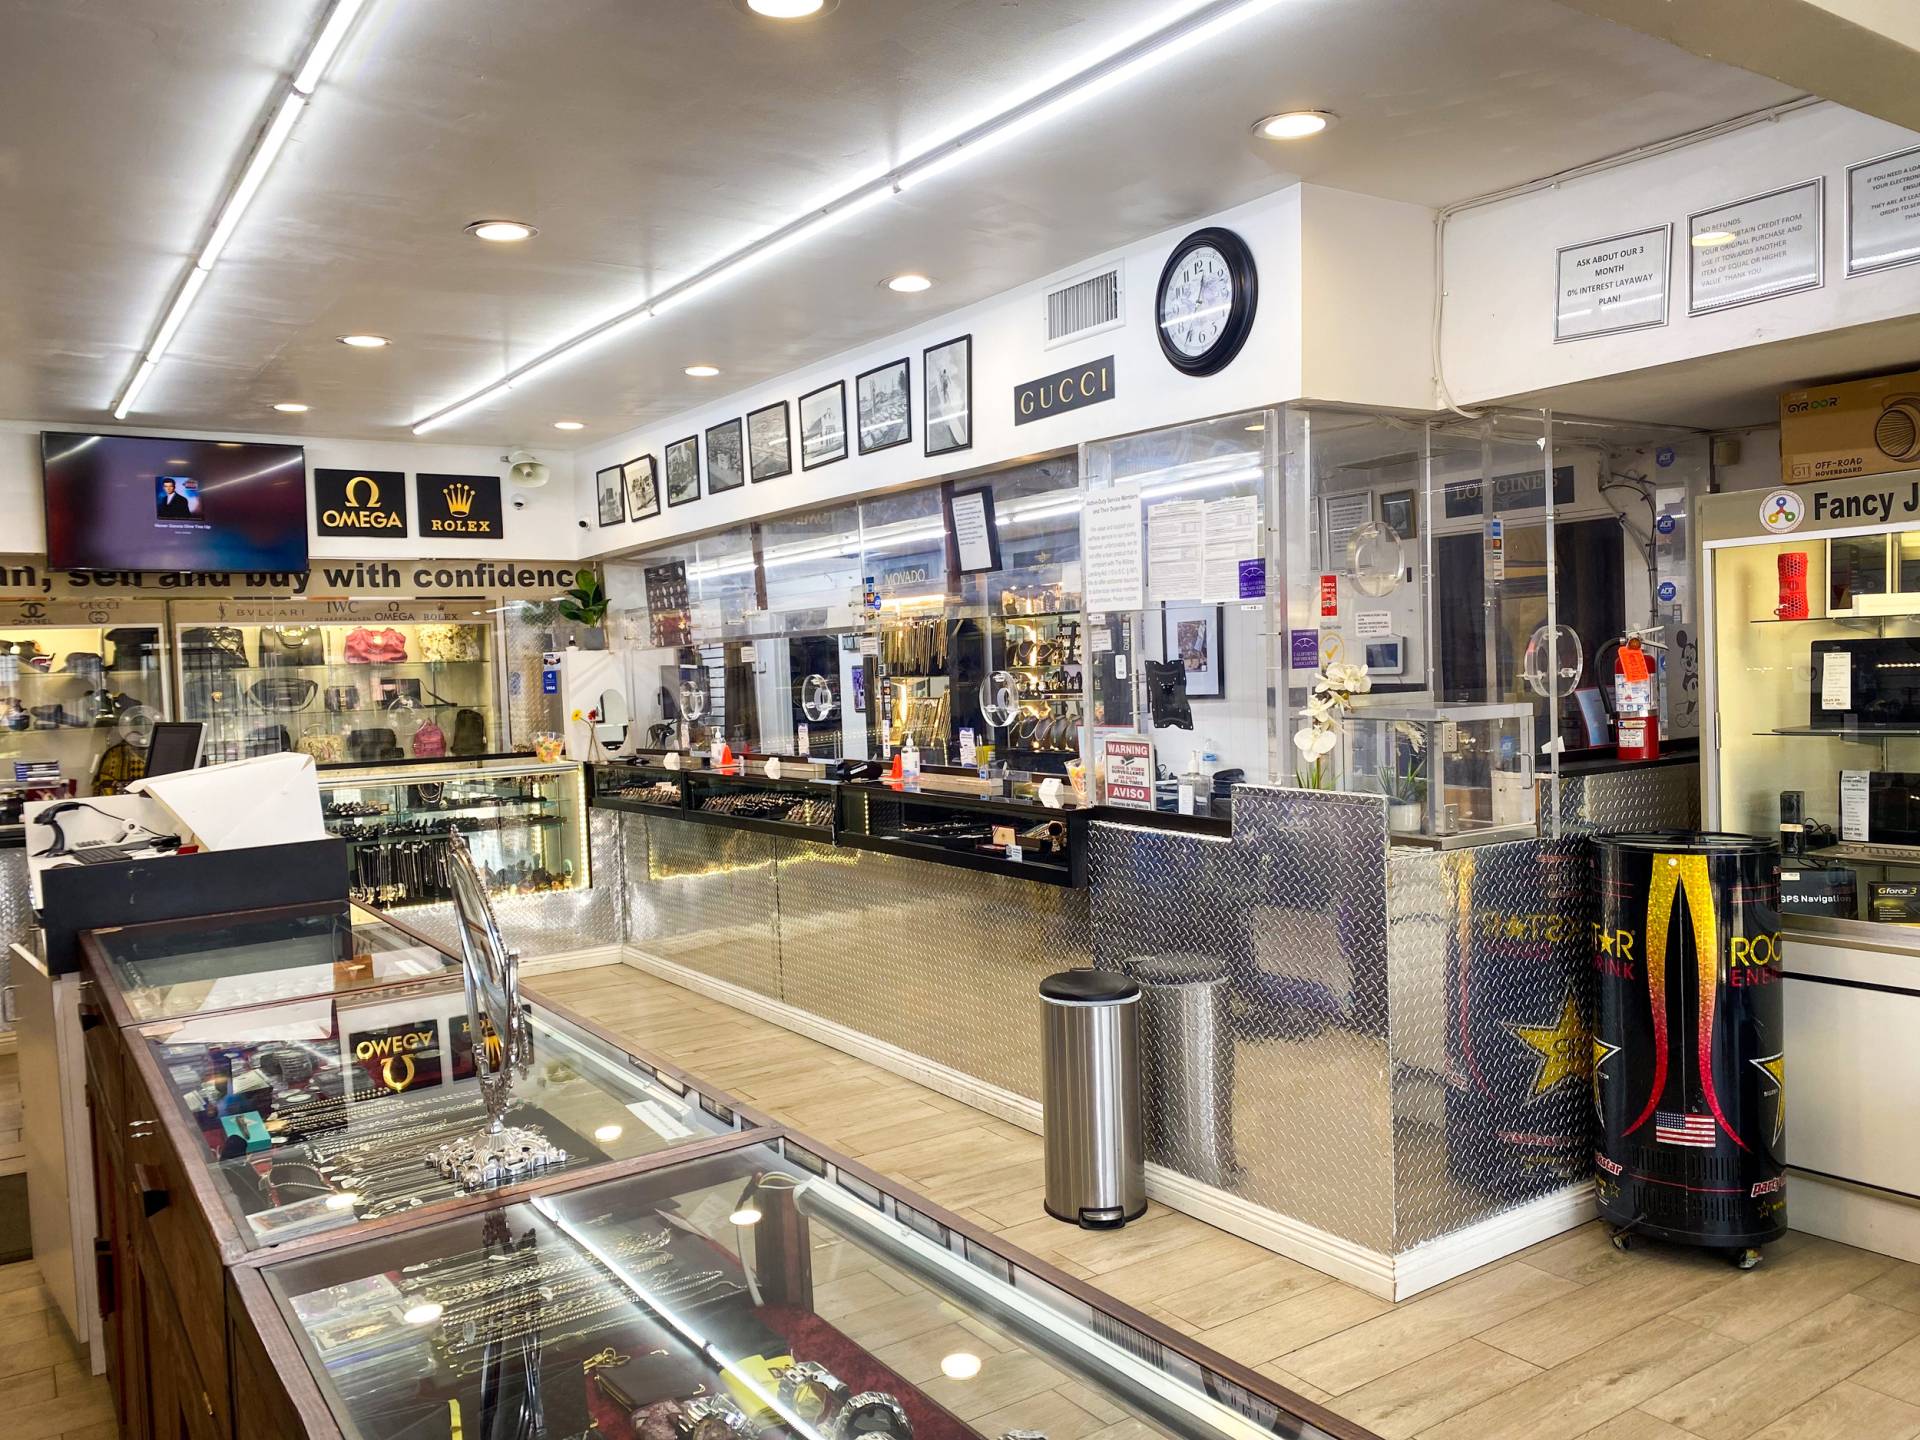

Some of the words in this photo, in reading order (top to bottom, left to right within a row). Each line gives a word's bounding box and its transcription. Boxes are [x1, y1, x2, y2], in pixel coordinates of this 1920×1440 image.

[1873, 174, 1886, 182] YOU
[1887, 169, 1903, 178] NEED
[1872, 182, 1889, 191] YOUR
[1871, 201, 1886, 210] THEY
[1880, 207, 1900, 217] ORDER
[1757, 218, 1781, 231] CREDIT
[1781, 213, 1803, 225] FROM
[1701, 246, 1719, 257] YOUR
[1720, 239, 1751, 252] ORIGINAL
[1751, 228, 1787, 243] PURCHASE
[1787, 224, 1803, 234] AND
[1576, 258, 1591, 268] ASK
[1592, 251, 1619, 265] ABOUT
[1620, 247, 1638, 258] OUR
[1639, 246, 1645, 254] 3
[1701, 258, 1713, 268] USE
[1721, 249, 1754, 263] TOWARDS
[1754, 239, 1788, 253] ANOTHER
[1194, 260, 1204, 275] 12
[1594, 264, 1625, 277] MONTH
[1701, 267, 1717, 278] ITEM
[1727, 260, 1749, 271] EQUAL
[1750, 256, 1761, 266] OR
[1761, 250, 1788, 262] HIGHER
[1183, 269, 1190, 283] 11
[1217, 268, 1224, 282] 2
[1725, 271, 1746, 281] THANK
[1748, 267, 1762, 277] YOU
[1567, 288, 1579, 298] 0%
[1579, 281, 1614, 295] INTEREST
[1615, 272, 1654, 288] LAYAWAY
[1198, 331, 1206, 344] 6
[1020, 367, 1108, 416] GUCCI
[1815, 457, 1863, 470] OFF-ROAD
[1815, 466, 1863, 477] HOVERBOARD
[1456, 471, 1558, 500] LOGINES
[1814, 491, 1895, 522] Fancy
[1903, 482, 1919, 512] J
[323, 510, 403, 529] OMEGA
[431, 519, 491, 533] ROLEX
[323, 563, 400, 588] with
[885, 568, 926, 585] MOVADO
[79, 601, 120, 610] GUCCI
[236, 607, 305, 617] BVLGARI
[327, 601, 359, 614] IWC
[374, 612, 415, 621] OMEGA
[423, 613, 459, 621] ROLEX
[1107, 743, 1148, 756] WARNING
[1112, 786, 1145, 799] AVISO
[1910, 887, 1918, 895] 3
[1781, 895, 1799, 903] GPS
[1800, 894, 1852, 904] Navigation
